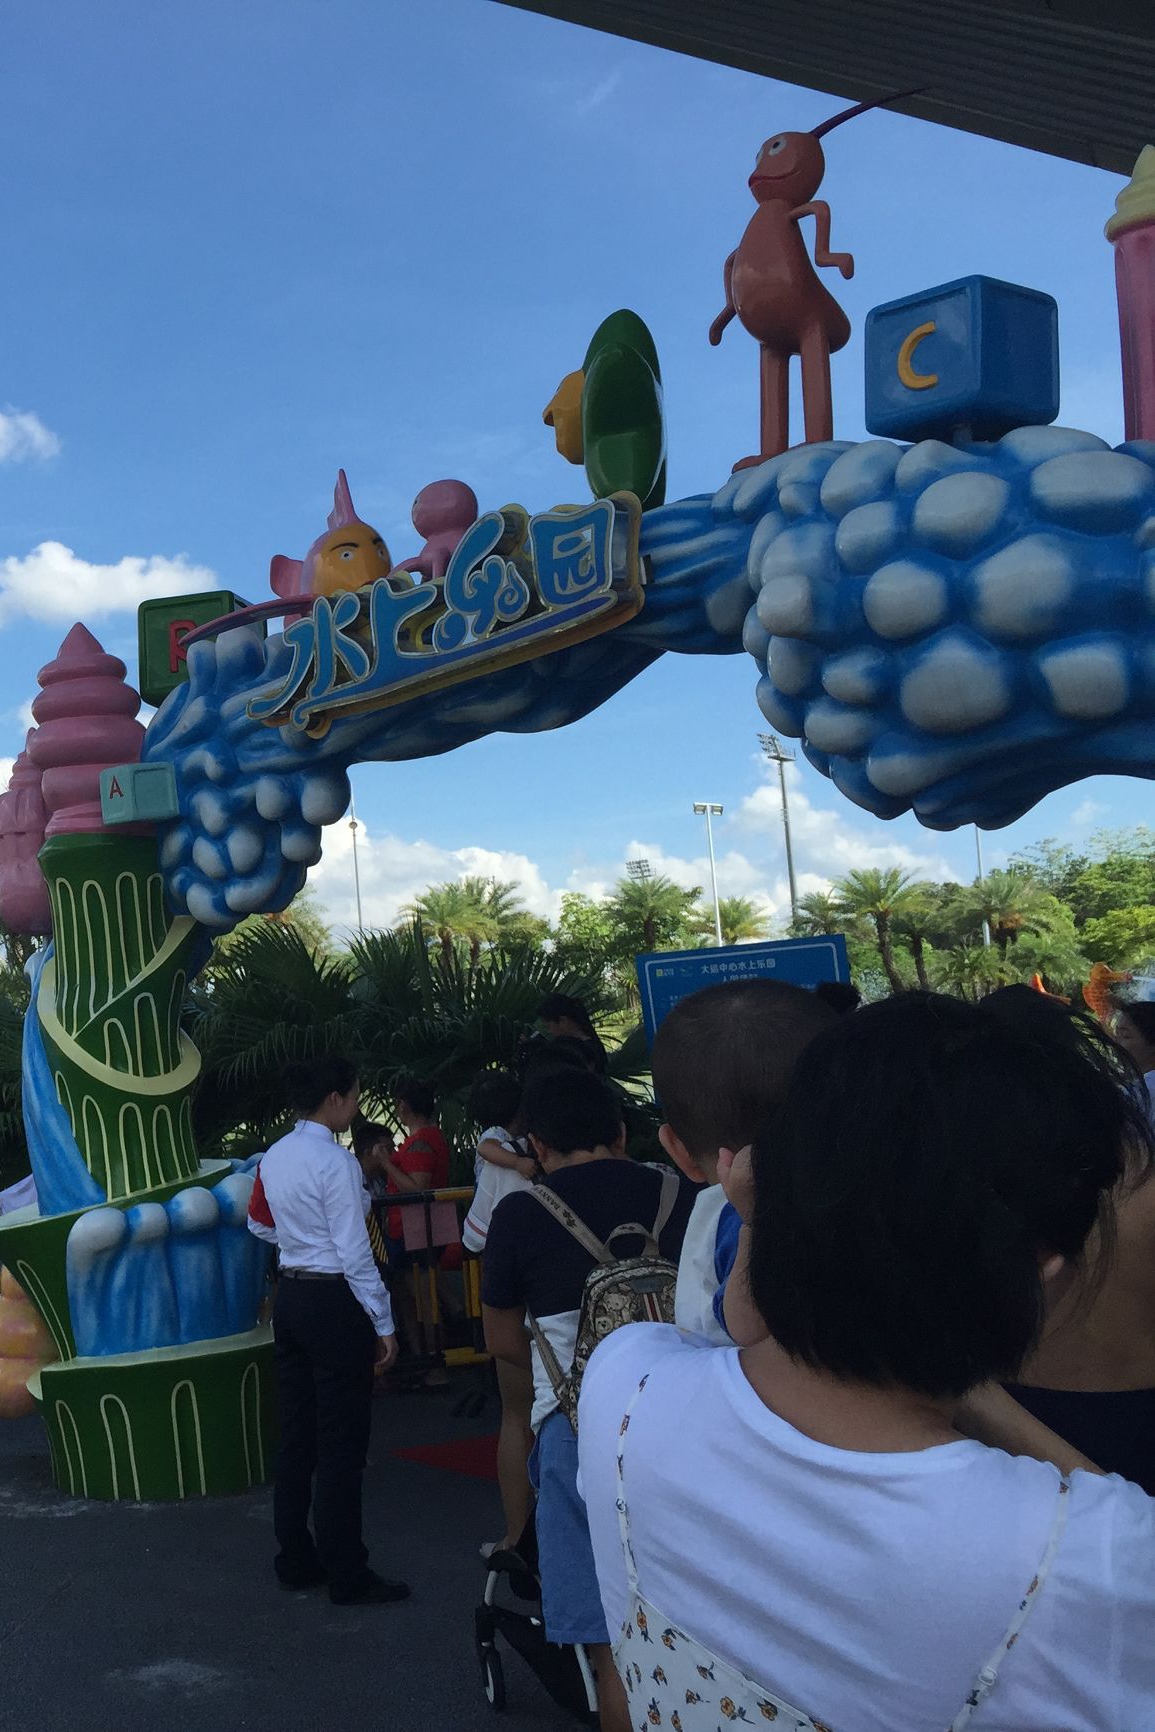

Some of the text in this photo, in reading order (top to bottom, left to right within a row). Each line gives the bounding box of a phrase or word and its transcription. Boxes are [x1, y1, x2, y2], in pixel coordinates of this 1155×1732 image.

[897, 320, 939, 390] C
[248, 499, 615, 720] 水上乐园
[109, 775, 124, 800] A
